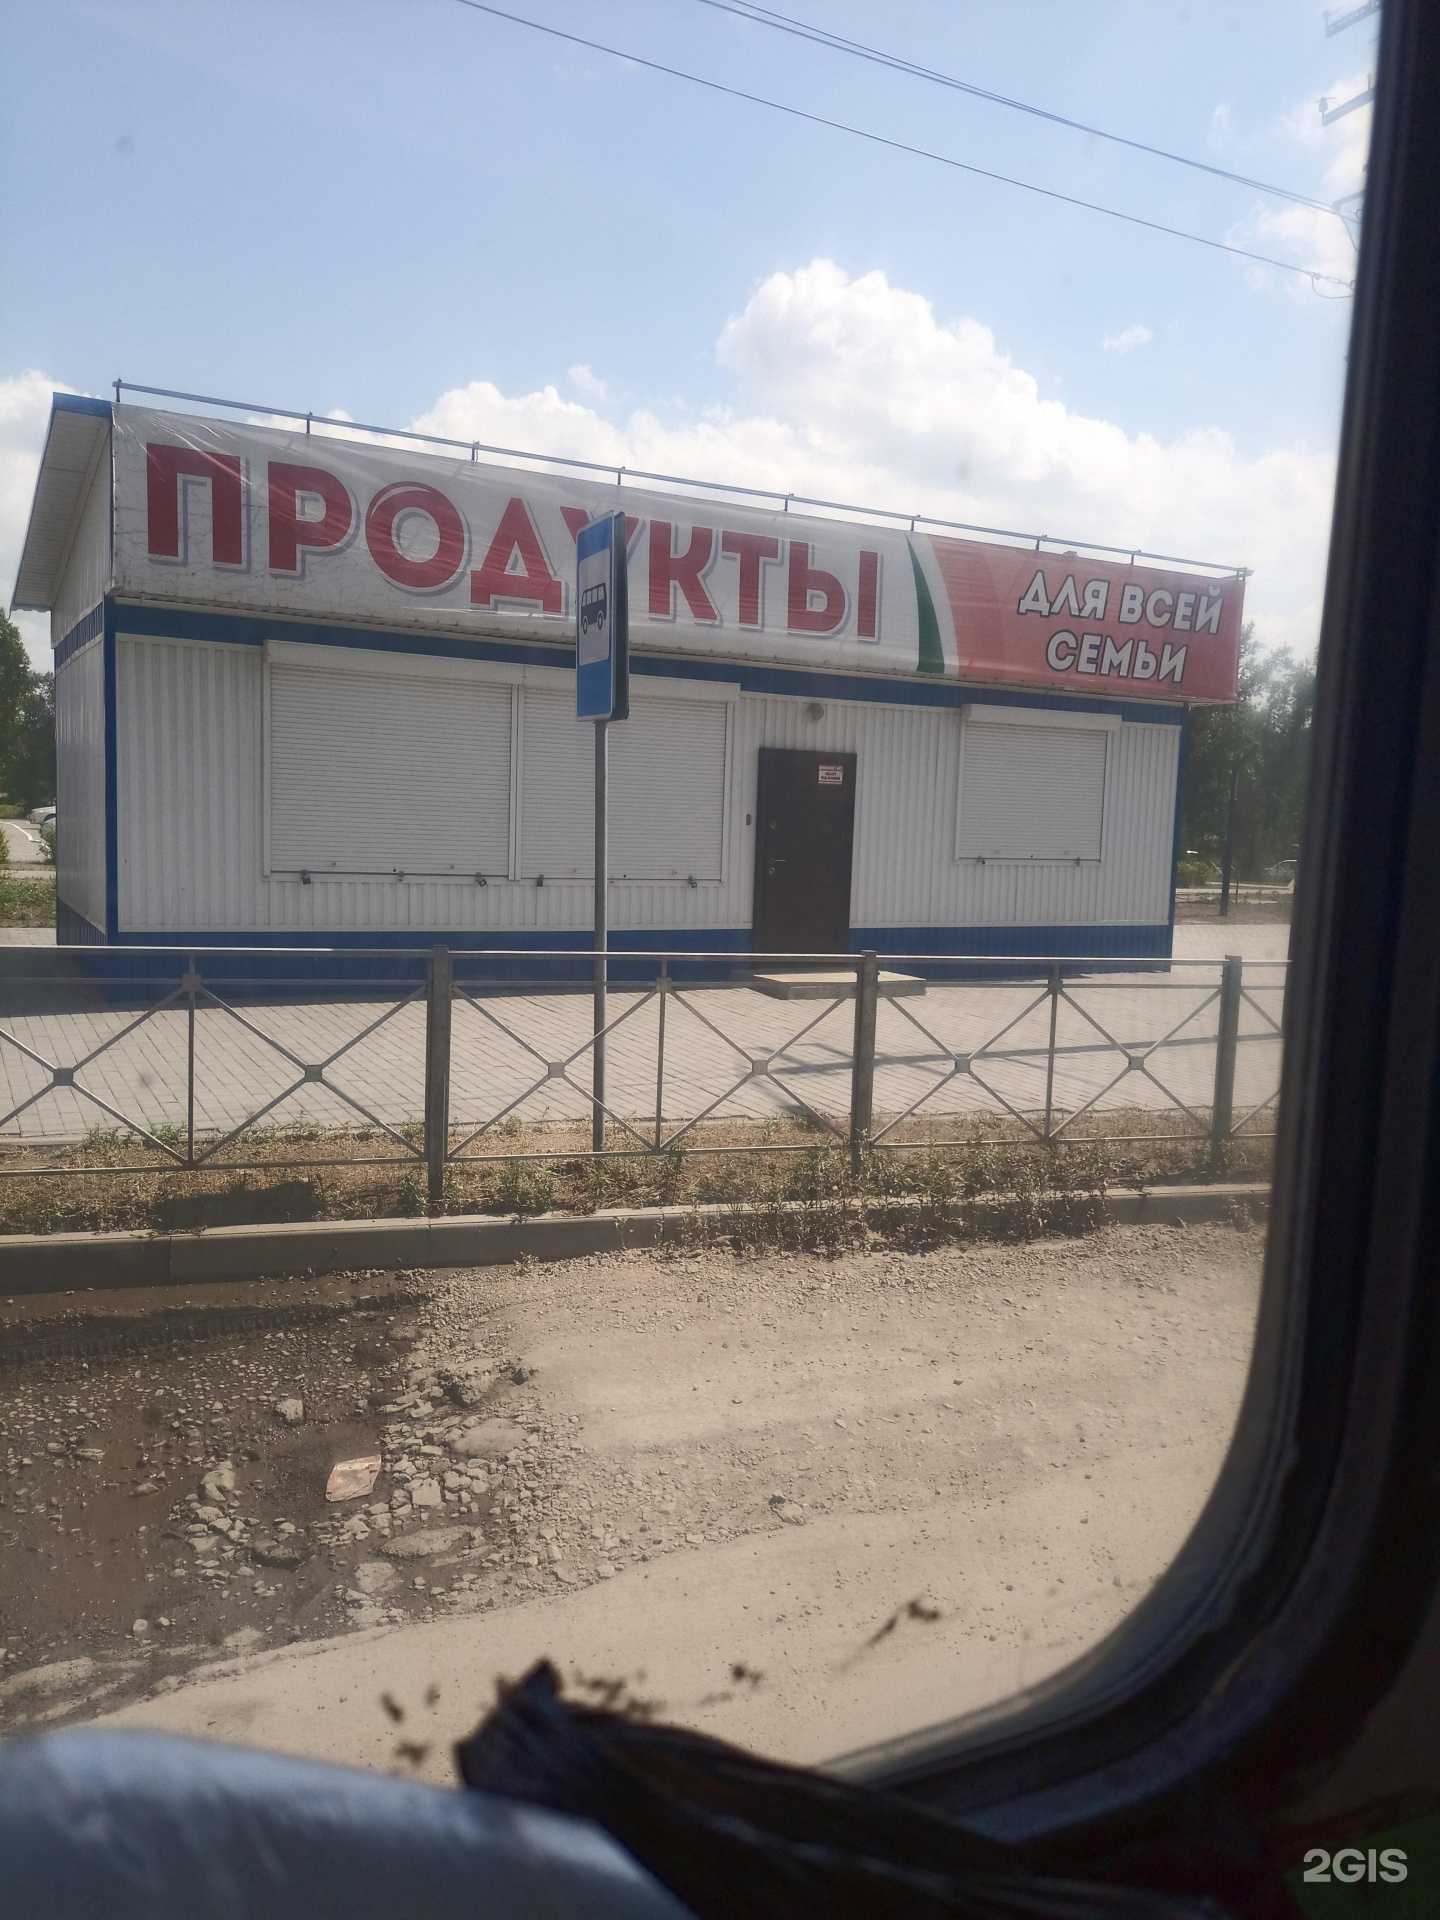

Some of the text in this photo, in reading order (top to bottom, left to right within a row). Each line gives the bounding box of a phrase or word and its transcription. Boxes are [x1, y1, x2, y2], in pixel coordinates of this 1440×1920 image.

[1018, 570, 1223, 634] ДЛЯ ВСЕЙ
[1046, 630, 1187, 683] СЕМЬИ
